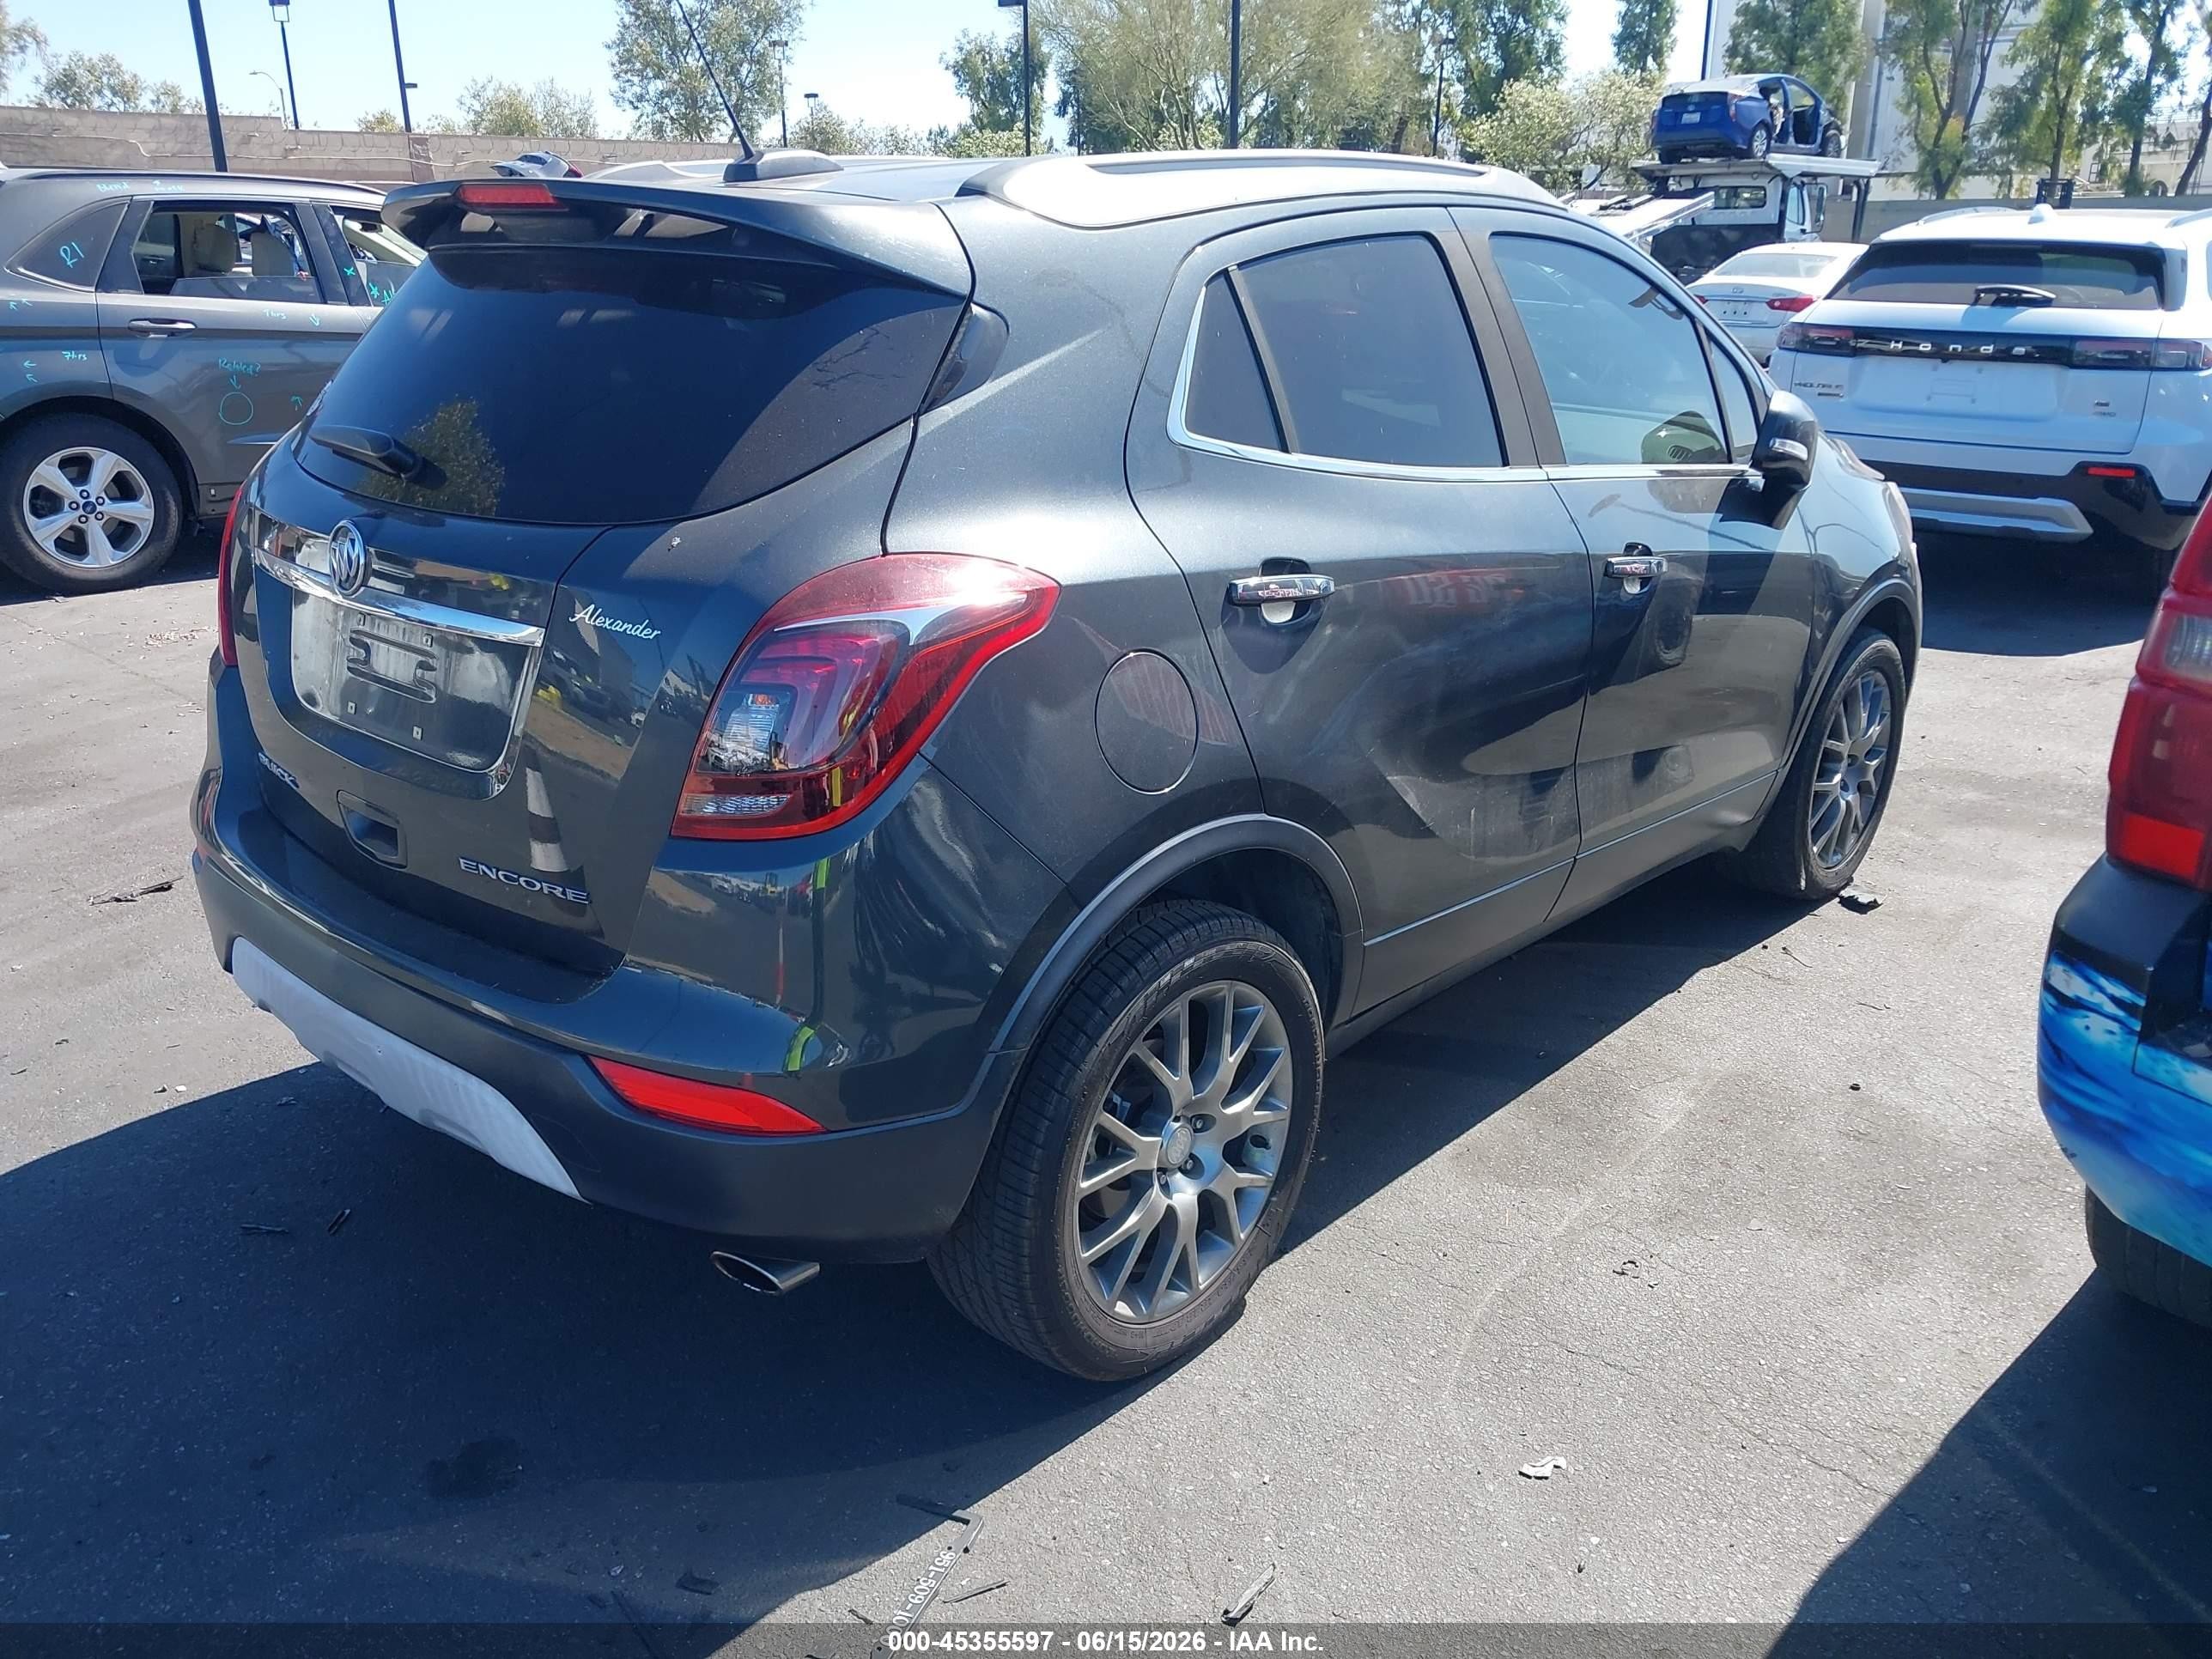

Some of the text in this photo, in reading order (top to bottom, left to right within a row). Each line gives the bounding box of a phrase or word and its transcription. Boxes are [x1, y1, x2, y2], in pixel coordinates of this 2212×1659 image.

[1889, 339, 2027, 357] Honda
[568, 604, 661, 640] Alexander
[258, 751, 296, 789] BUICK
[459, 856, 590, 905] ENCORE
